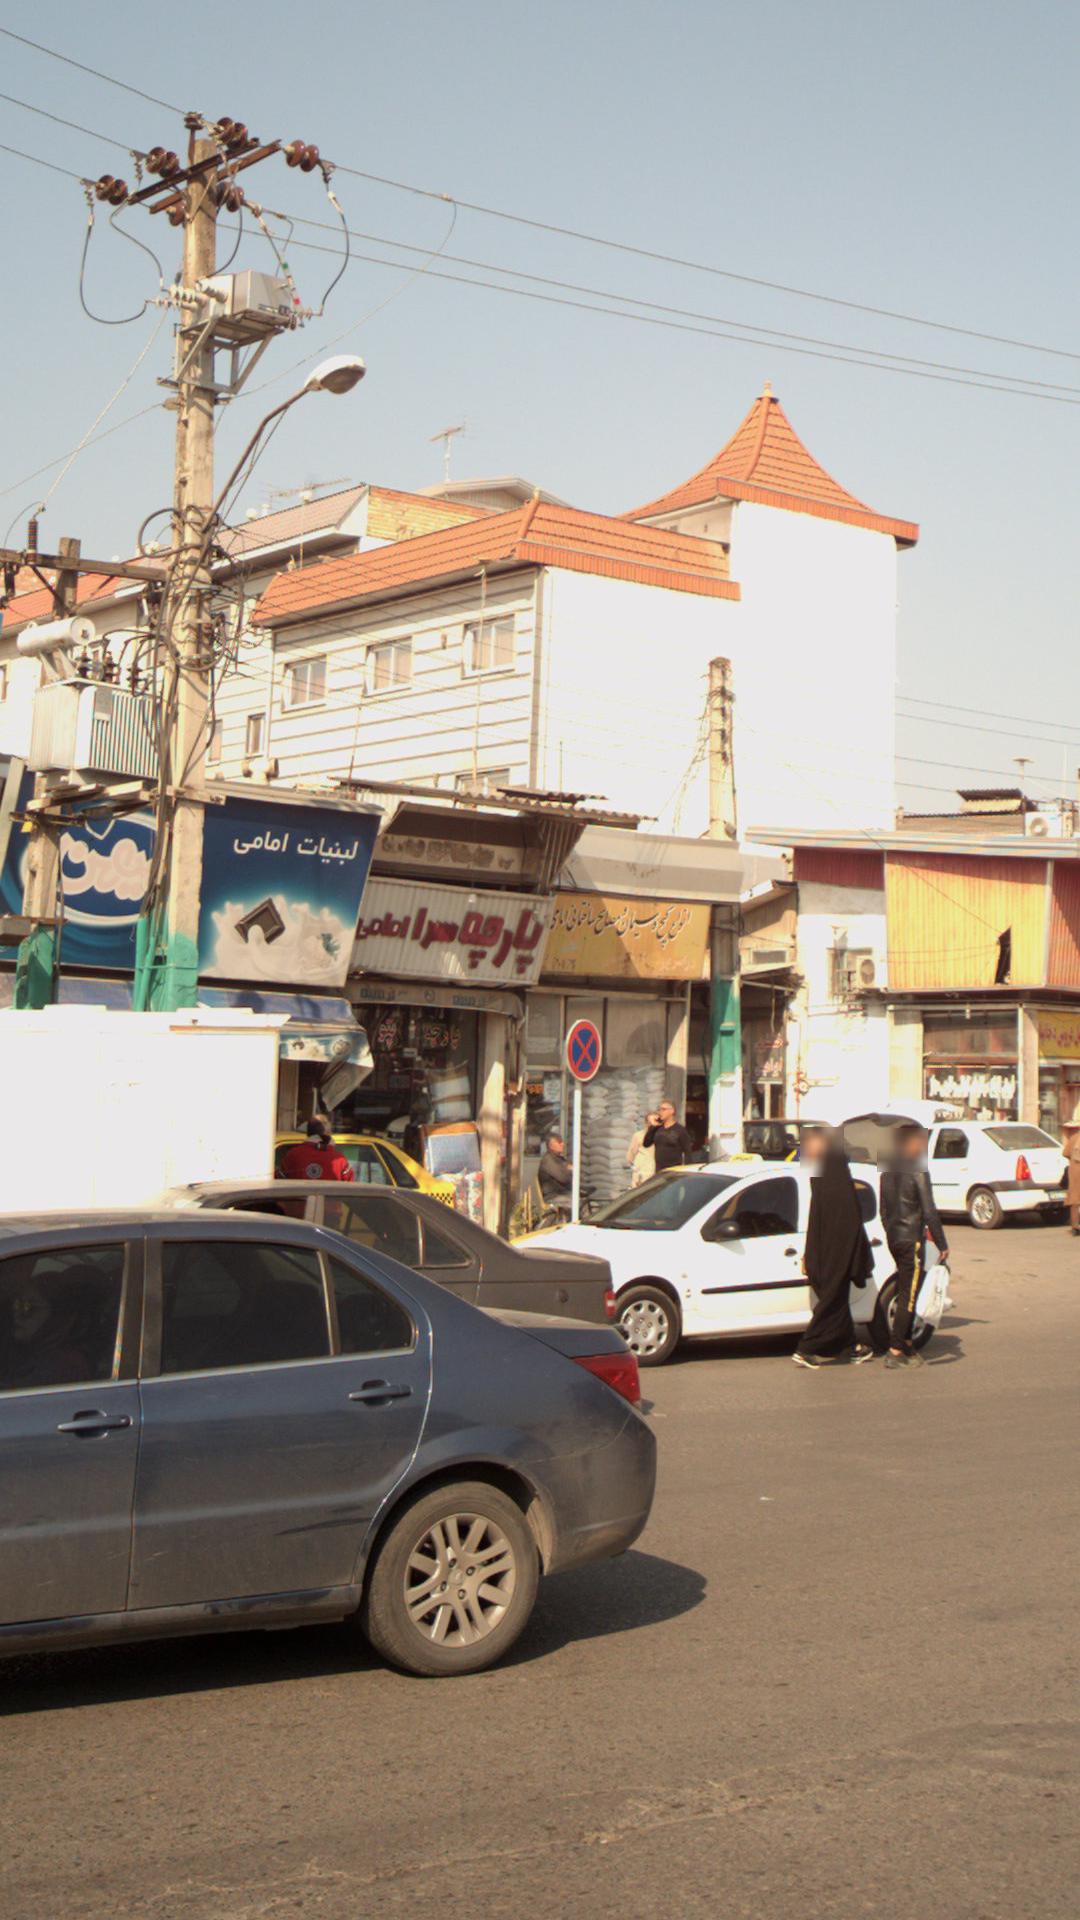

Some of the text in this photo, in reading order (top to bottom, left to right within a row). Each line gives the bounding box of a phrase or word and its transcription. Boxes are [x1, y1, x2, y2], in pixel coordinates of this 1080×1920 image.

[233, 831, 290, 855] امامی
[297, 837, 359, 866] لبنیات
[60, 832, 153, 901] یهن
[355, 906, 544, 975] پارچه سرا امامی
[655, 904, 677, 950] گچ
[667, 908, 693, 941] انواع
